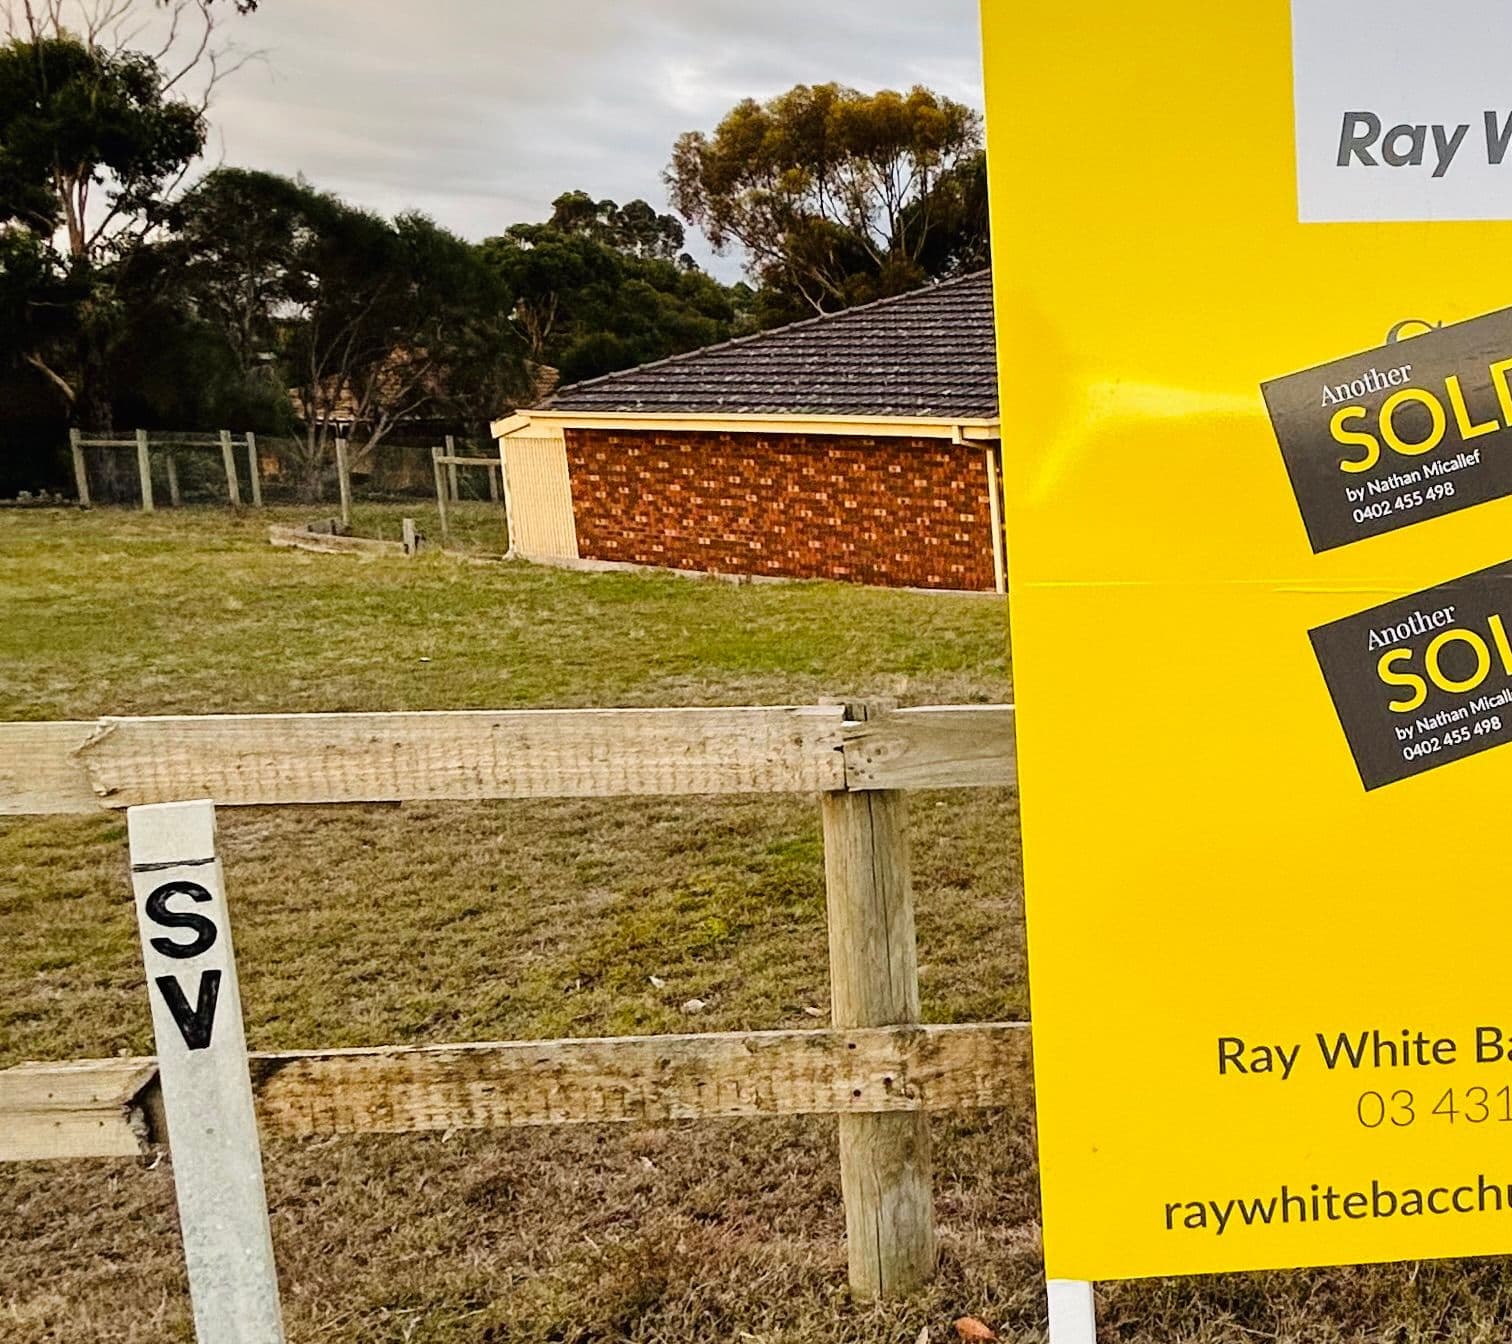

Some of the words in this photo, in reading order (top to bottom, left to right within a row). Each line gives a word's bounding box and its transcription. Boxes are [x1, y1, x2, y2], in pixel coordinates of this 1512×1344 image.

[1336, 110, 1470, 178] Ray
[1321, 364, 1413, 407] Another
[1345, 488, 1366, 503] by
[1366, 468, 1422, 496] Nathan
[1422, 449, 1481, 480] Micallef
[1352, 501, 1393, 524] 0402
[1394, 491, 1424, 511] 455
[1425, 482, 1455, 503] 498
[1368, 605, 1456, 652] Another
[1395, 725, 1415, 741] by
[1415, 705, 1469, 735] Nathan
[1402, 740, 1442, 762] 0402
[1443, 726, 1472, 746] 455
[1473, 715, 1502, 736] 498
[1217, 1036, 1301, 1081] Ray
[1315, 1028, 1457, 1071] White
[1357, 1088, 1416, 1128] 03
